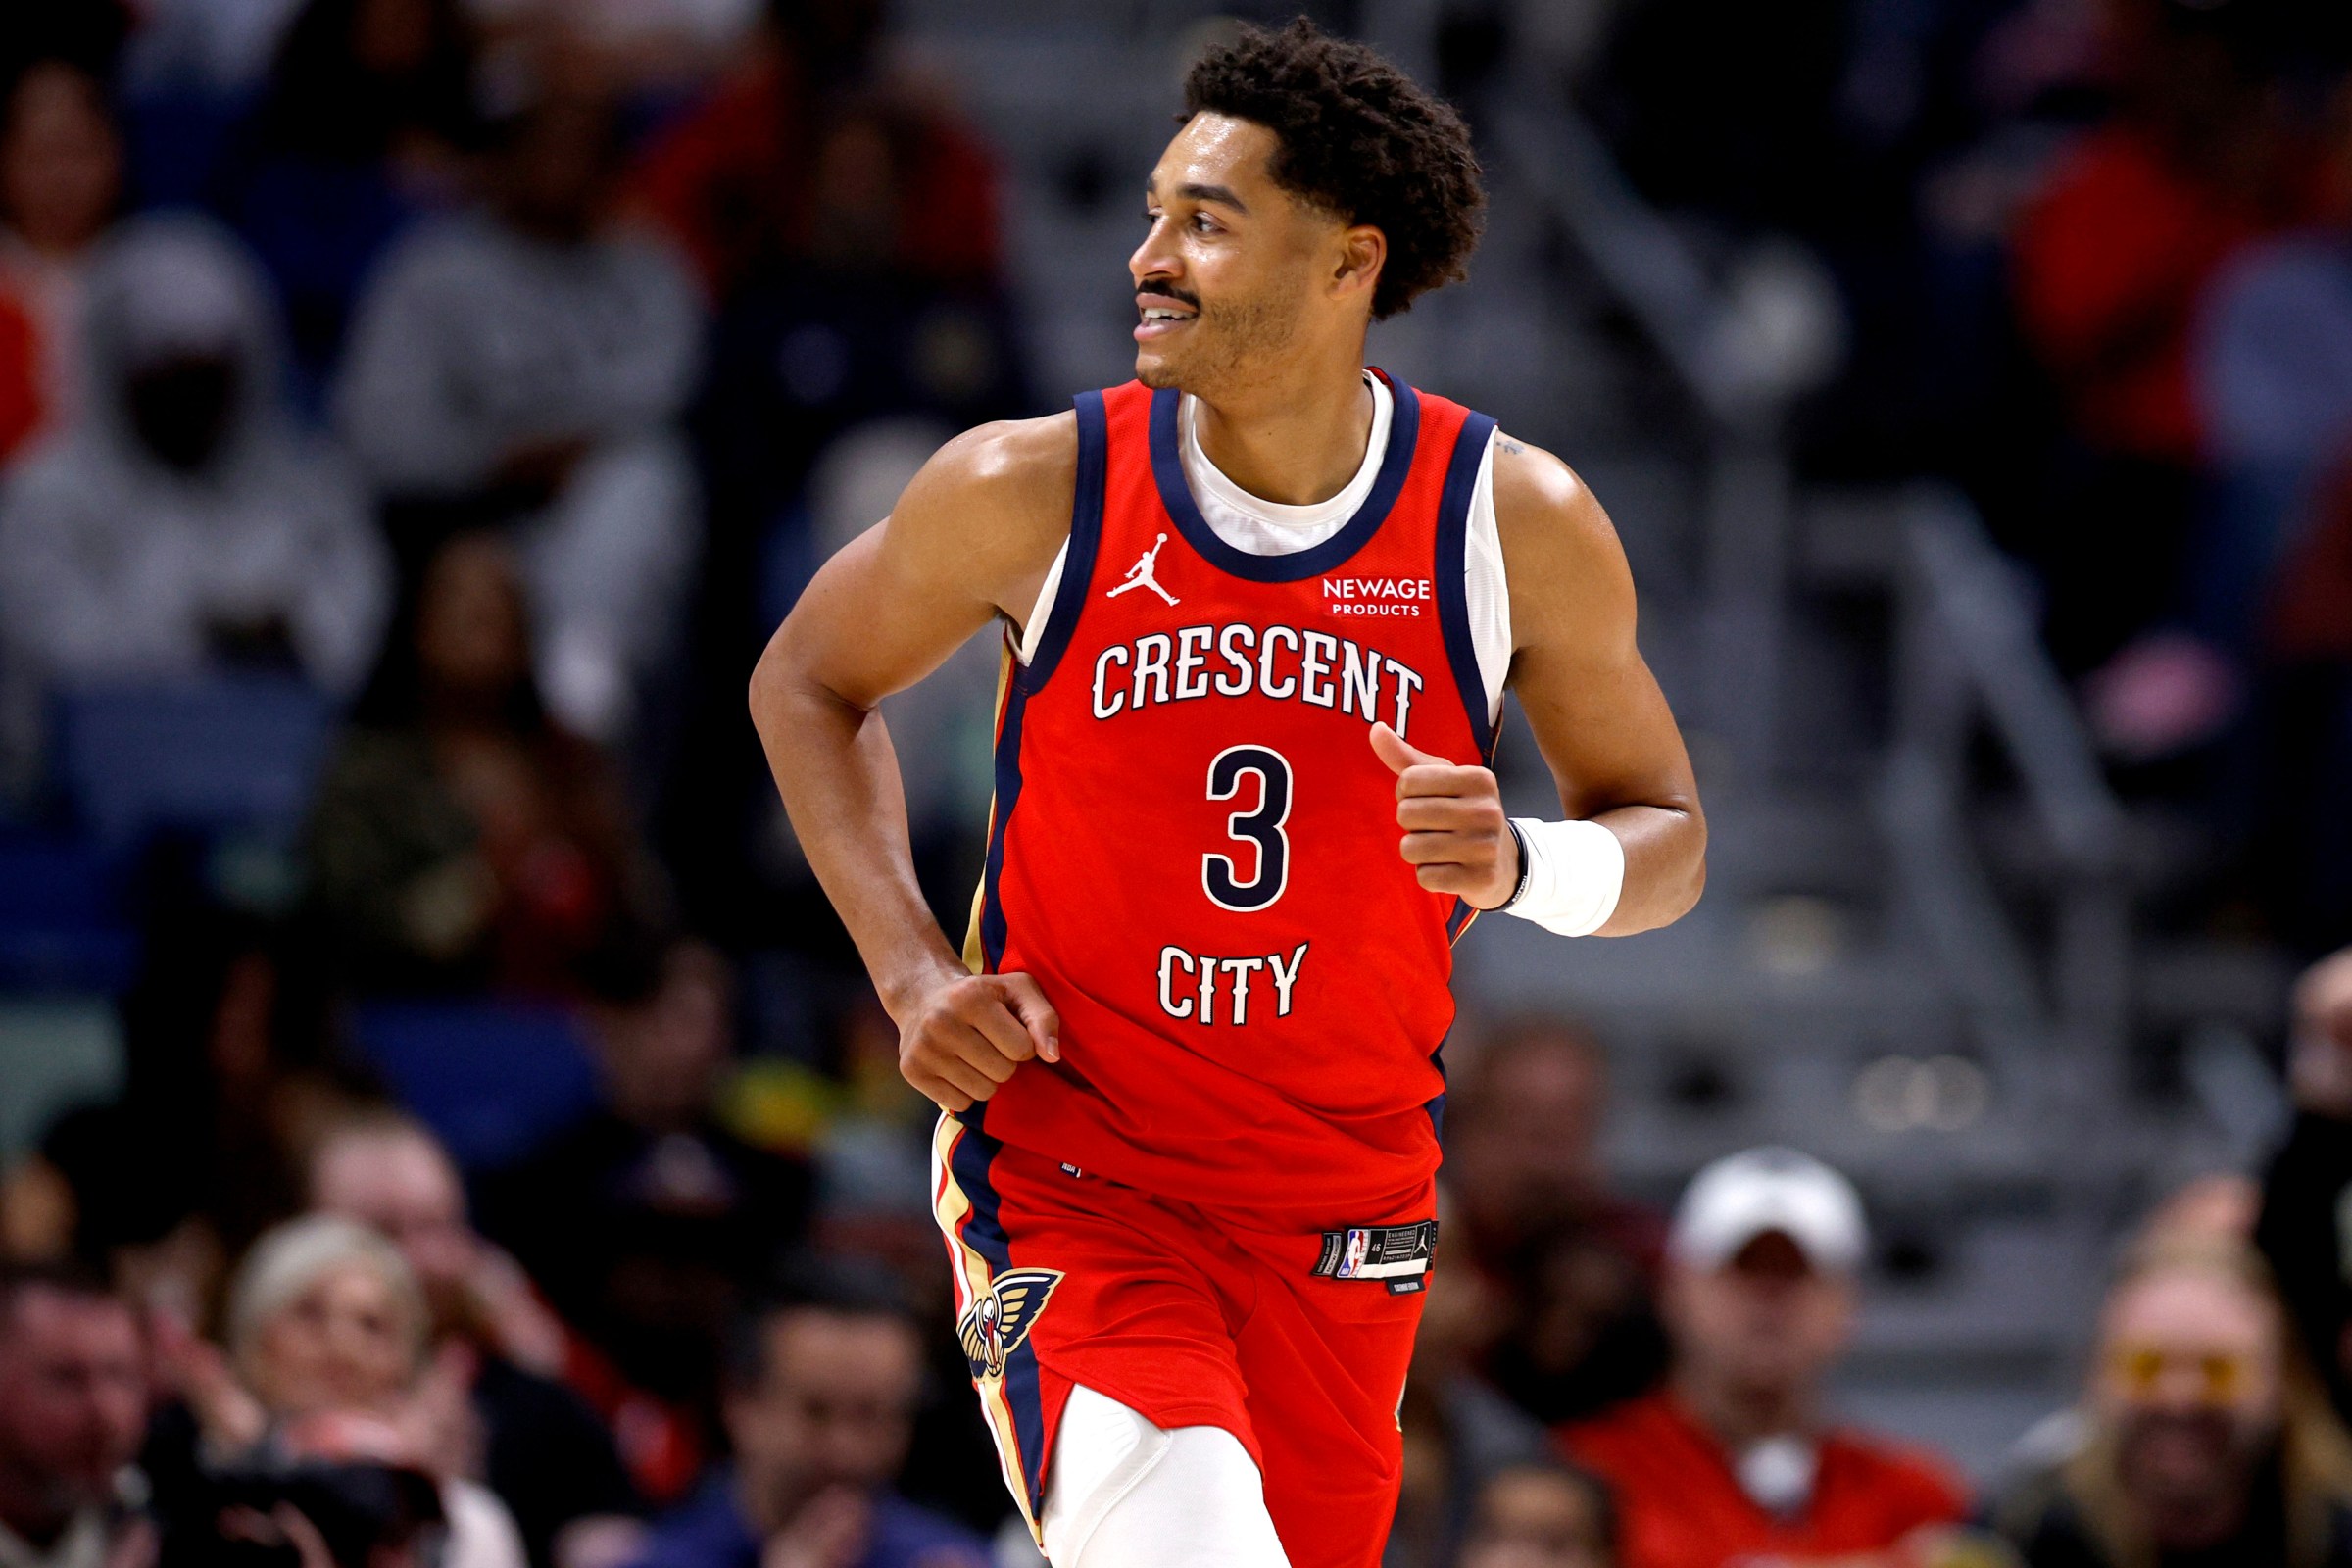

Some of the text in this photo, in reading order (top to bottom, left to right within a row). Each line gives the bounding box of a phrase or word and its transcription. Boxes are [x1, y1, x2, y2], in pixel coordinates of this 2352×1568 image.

[1323, 578, 1431, 600] NEWAGE
[1333, 604, 1420, 617] PRODUCTS
[1091, 622, 1424, 741] CRESCENT
[1201, 744, 1294, 913] 3
[1156, 939, 1310, 1026] CITY
[1371, 1243, 1382, 1252] 46
